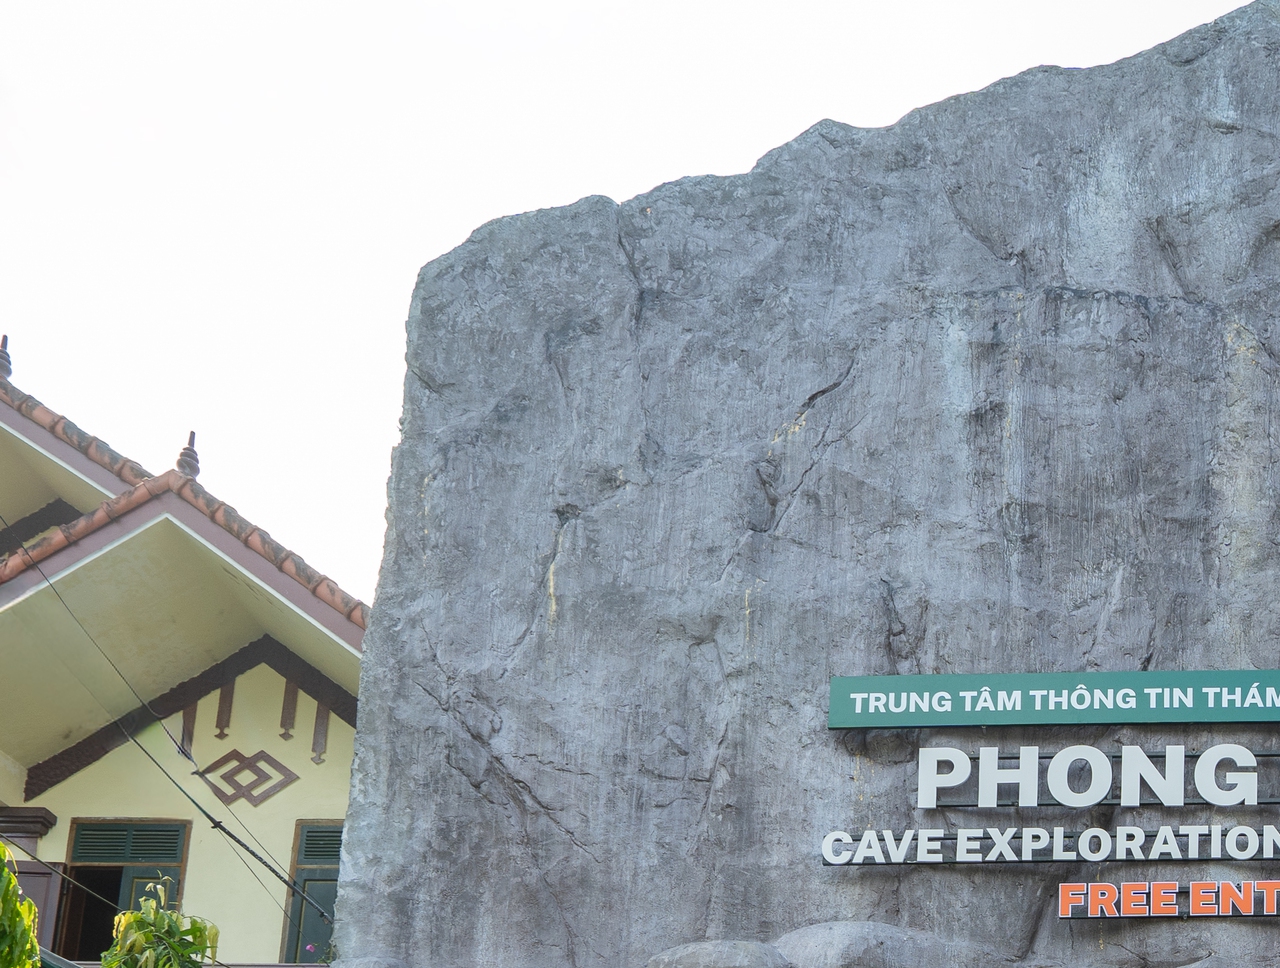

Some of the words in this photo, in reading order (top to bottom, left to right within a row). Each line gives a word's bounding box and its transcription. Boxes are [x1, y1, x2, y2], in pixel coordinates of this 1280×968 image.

[850, 691, 952, 713] TRUNG
[959, 686, 1022, 712] TÂM
[1029, 684, 1137, 710] THÔNG
[1144, 687, 1194, 709] TIN
[917, 743, 1258, 809] PHONG
[821, 828, 945, 865] CAVE
[1058, 881, 1179, 917] FREE
